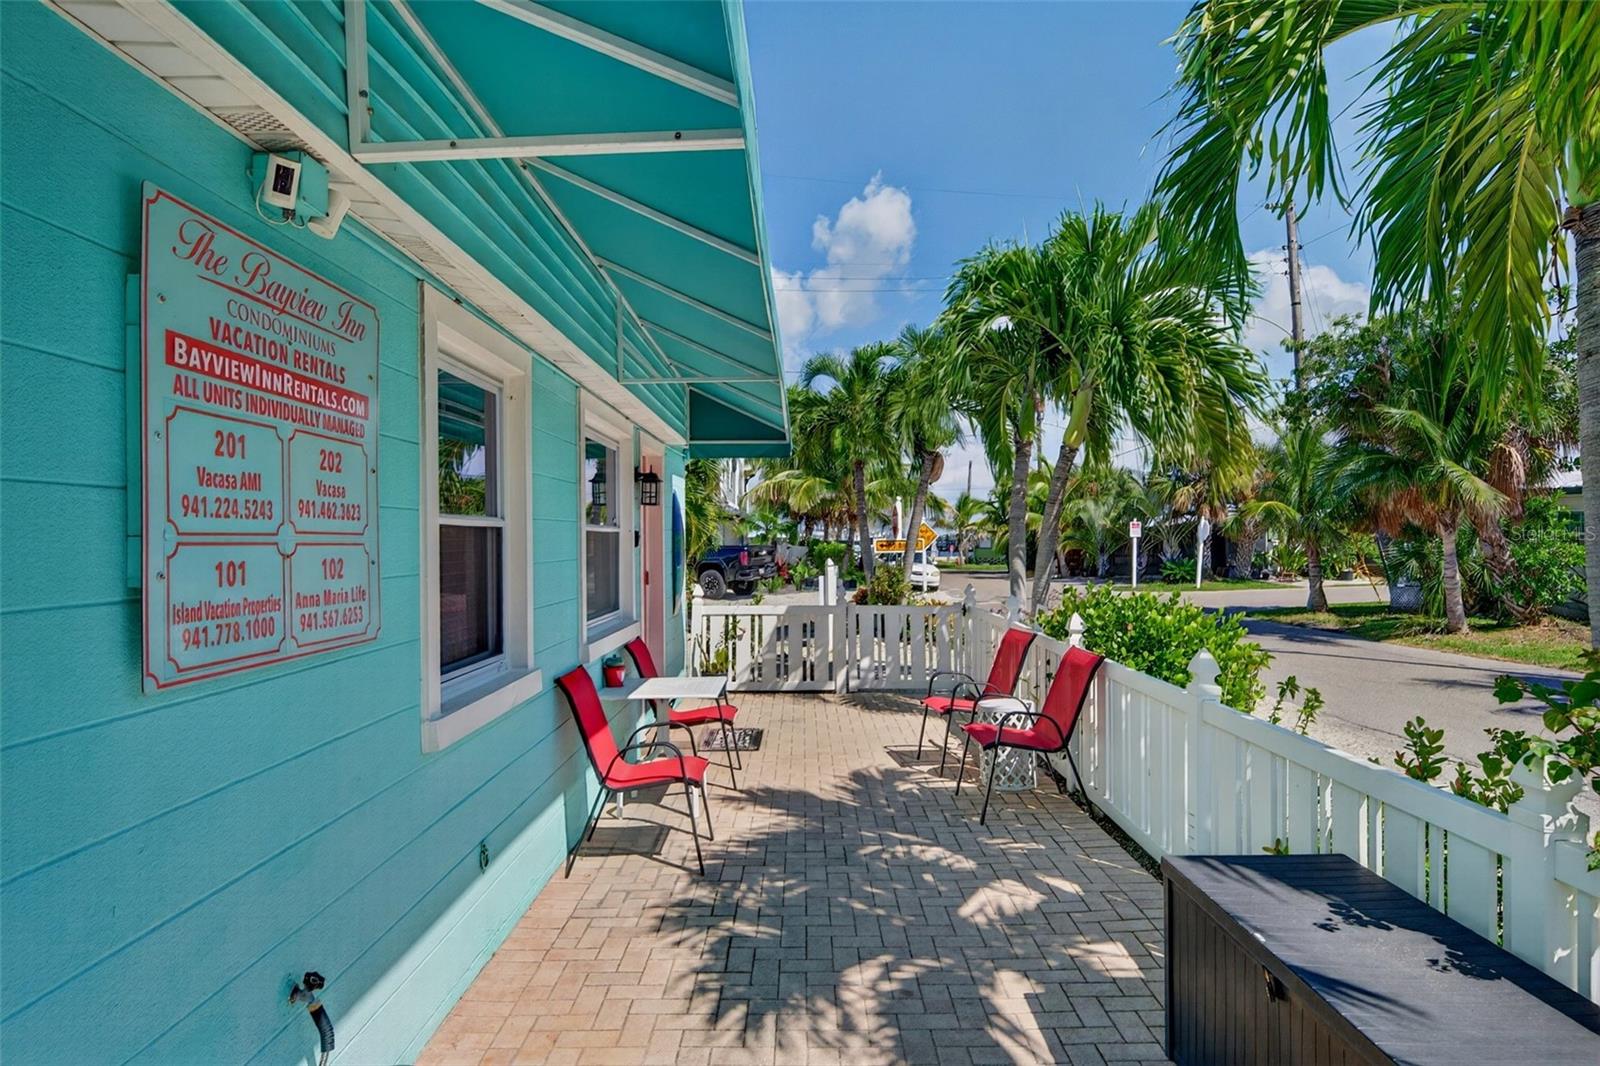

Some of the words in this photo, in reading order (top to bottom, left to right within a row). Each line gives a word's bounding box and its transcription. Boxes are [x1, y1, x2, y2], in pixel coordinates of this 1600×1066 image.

[172, 218, 229, 276] The
[234, 251, 328, 323] Bayview
[331, 300, 366, 342] Inn
[226, 299, 336, 357] CONDOMINIUMS
[209, 316, 288, 365] VACATION
[293, 351, 346, 384] RENTALS
[173, 373, 200, 400] ALL
[203, 386, 243, 412] UNITS
[245, 394, 321, 428] INDIVIDUALLY
[214, 430, 247, 460] 201
[319, 449, 343, 474] 202
[196, 466, 238, 491] Vacasa
[239, 471, 262, 492] AMI
[315, 479, 346, 499] Vacasa
[181, 494, 274, 521] 941.224.5243
[298, 499, 362, 522] 941.462.3623
[215, 560, 247, 588] 101
[321, 558, 344, 580] 102
[172, 602, 202, 626] Island
[204, 597, 242, 624] Vacation
[242, 593, 282, 618] Properties
[295, 591, 321, 610] Anna
[323, 588, 350, 606] Maria
[351, 585, 367, 602] Life
[299, 605, 364, 632] 941.567.6253
[181, 616, 276, 651] 941.778.1000
